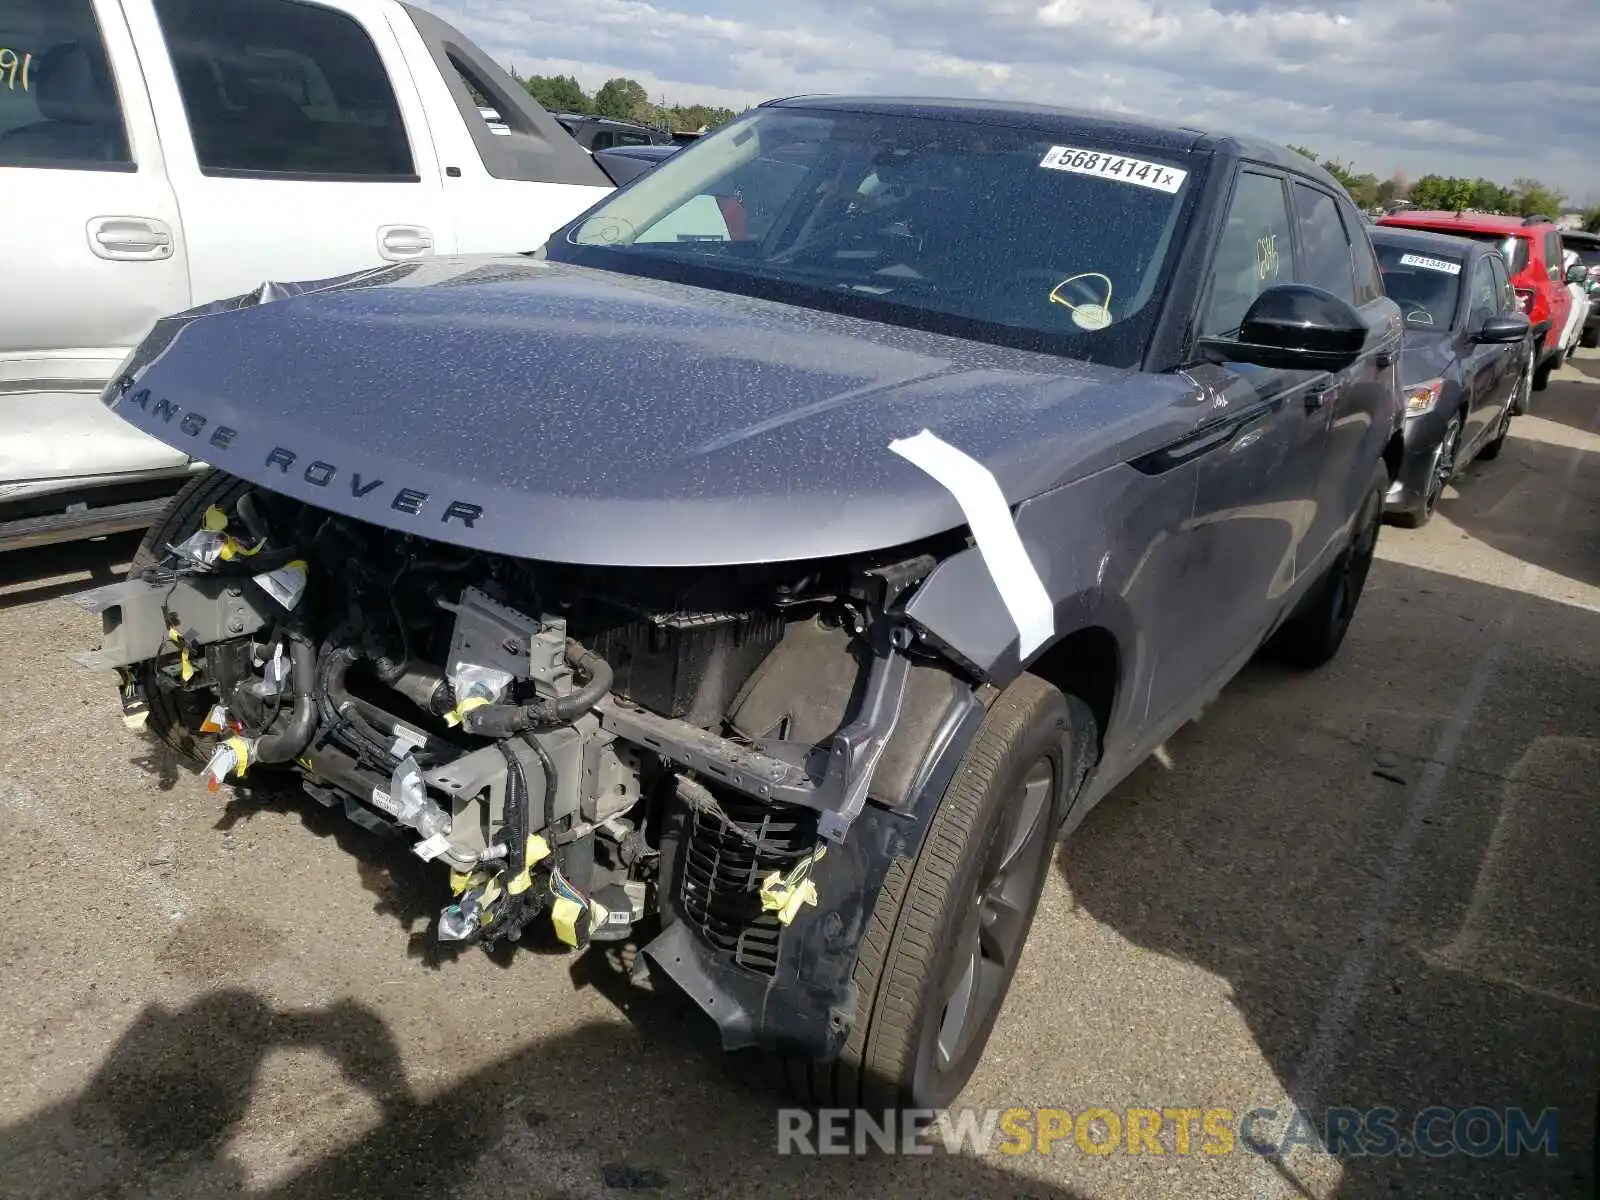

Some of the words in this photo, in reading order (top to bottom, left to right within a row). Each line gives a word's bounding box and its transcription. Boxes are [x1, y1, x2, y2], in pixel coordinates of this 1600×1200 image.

[0, 48, 32, 92] 91
[110, 375, 238, 451] RANGE
[265, 446, 484, 529] ROVER
